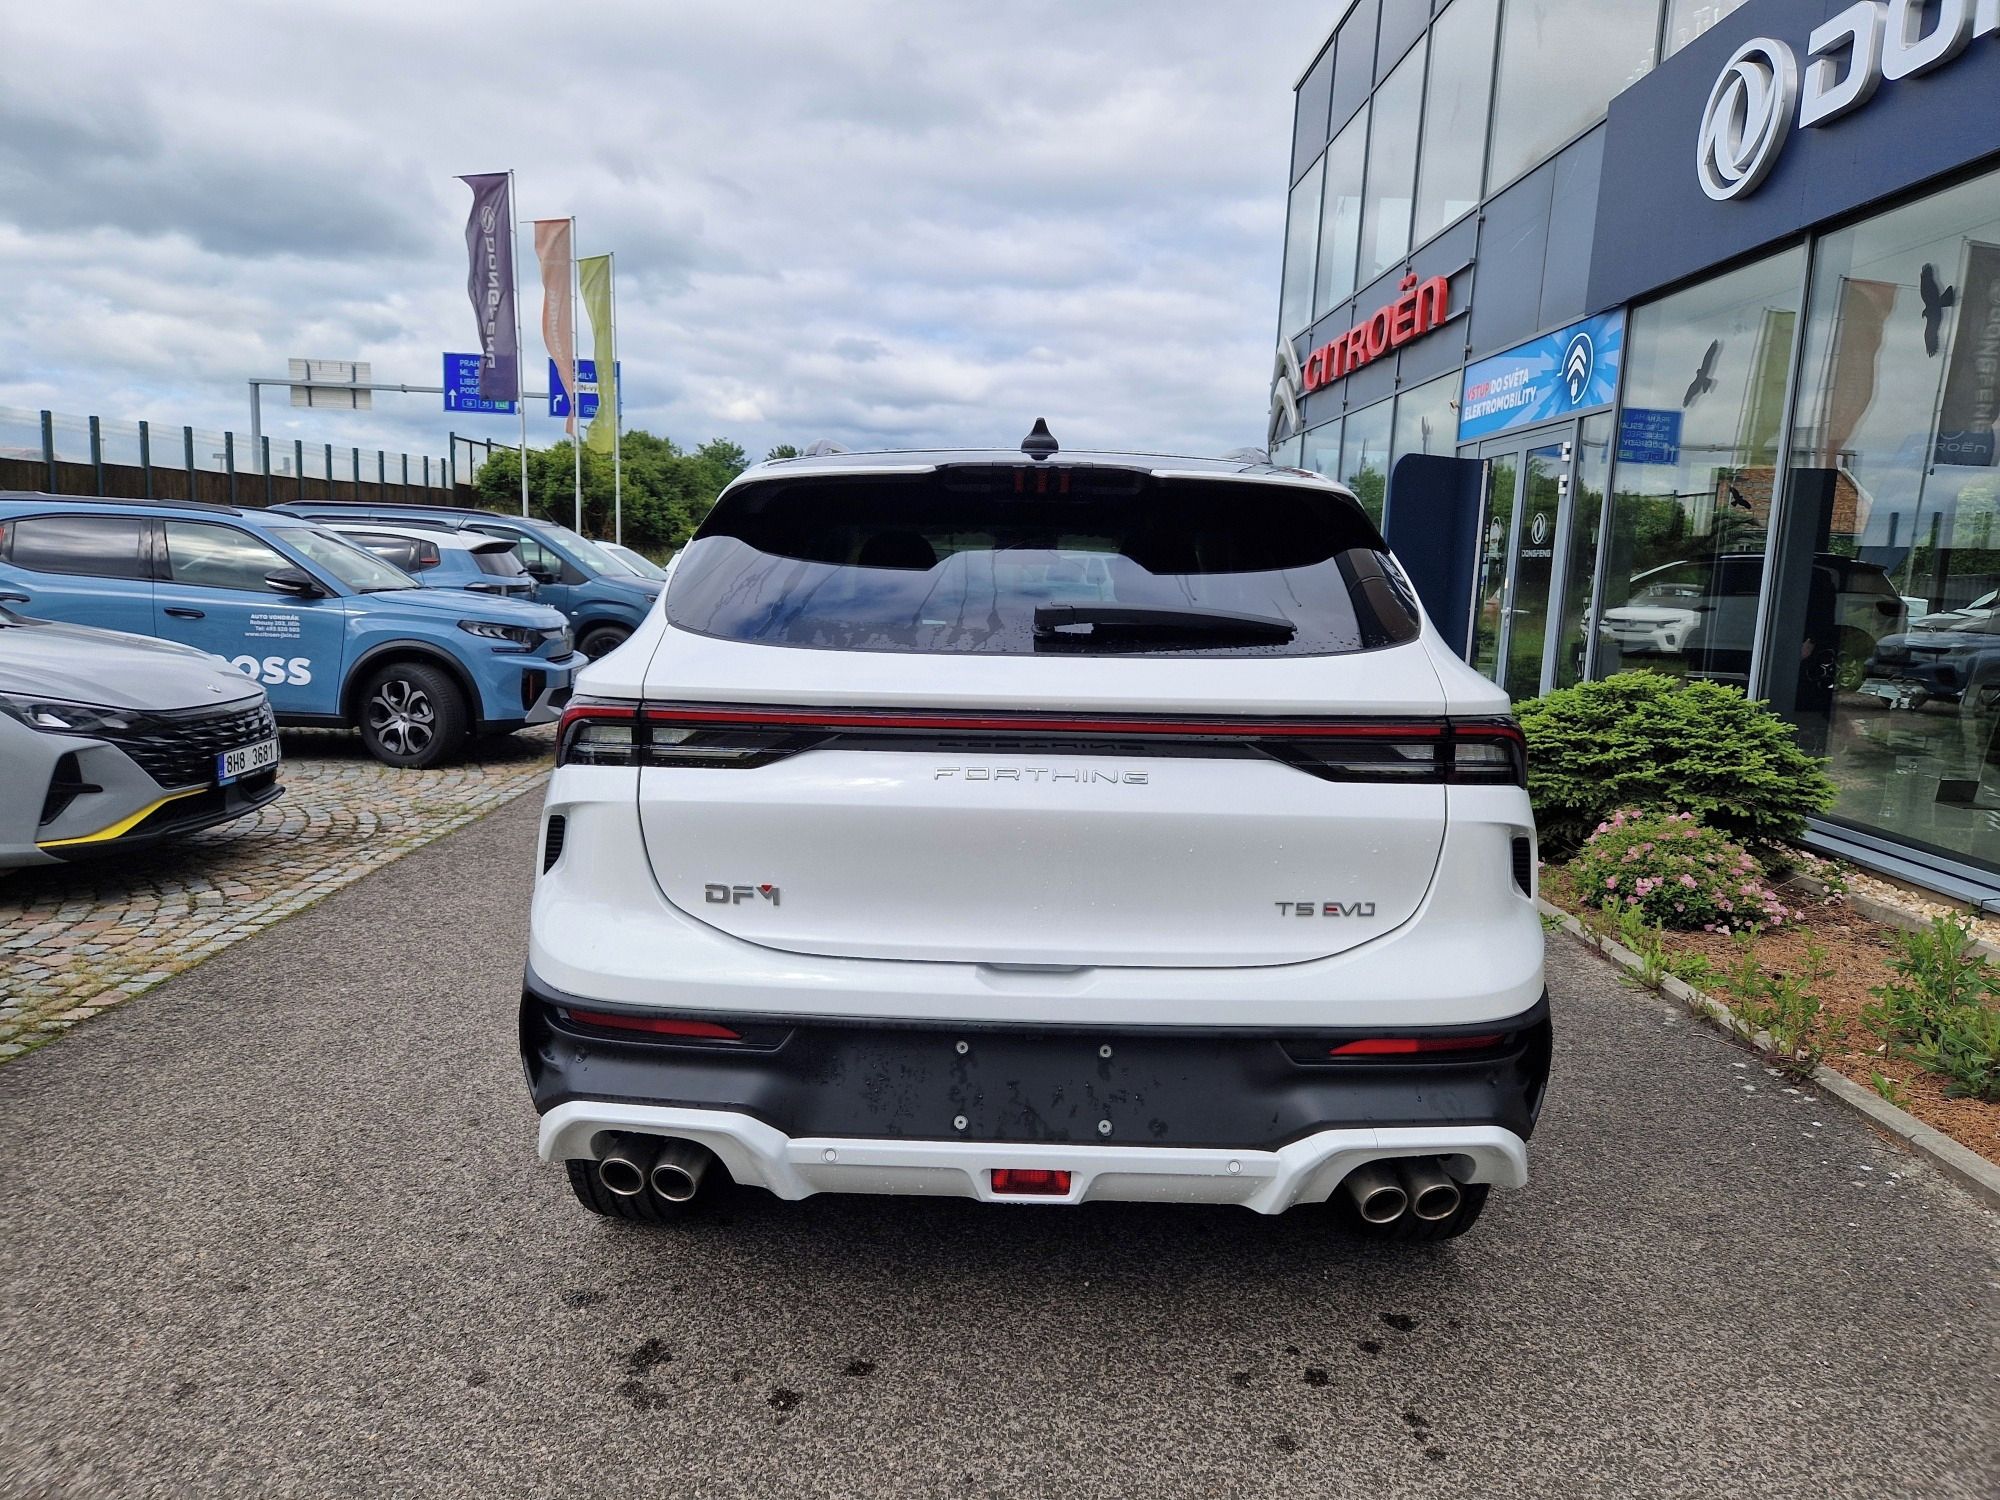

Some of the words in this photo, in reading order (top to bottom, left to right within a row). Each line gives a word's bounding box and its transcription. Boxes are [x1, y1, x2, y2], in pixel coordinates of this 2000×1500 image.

[1799, 0, 2000, 129] DO
[1467, 382, 1490, 401] VSTUP
[1490, 377, 1502, 394] DO
[1504, 367, 1529, 390] SVĚTA
[1464, 386, 1537, 421] ELEKTROMOBILITY
[226, 751, 246, 774] 8H8
[252, 742, 273, 766] 3681
[934, 766, 1149, 785] FORTHING
[704, 884, 781, 906] DFM
[1274, 902, 1315, 917] T5
[1322, 902, 1376, 917] EVO
